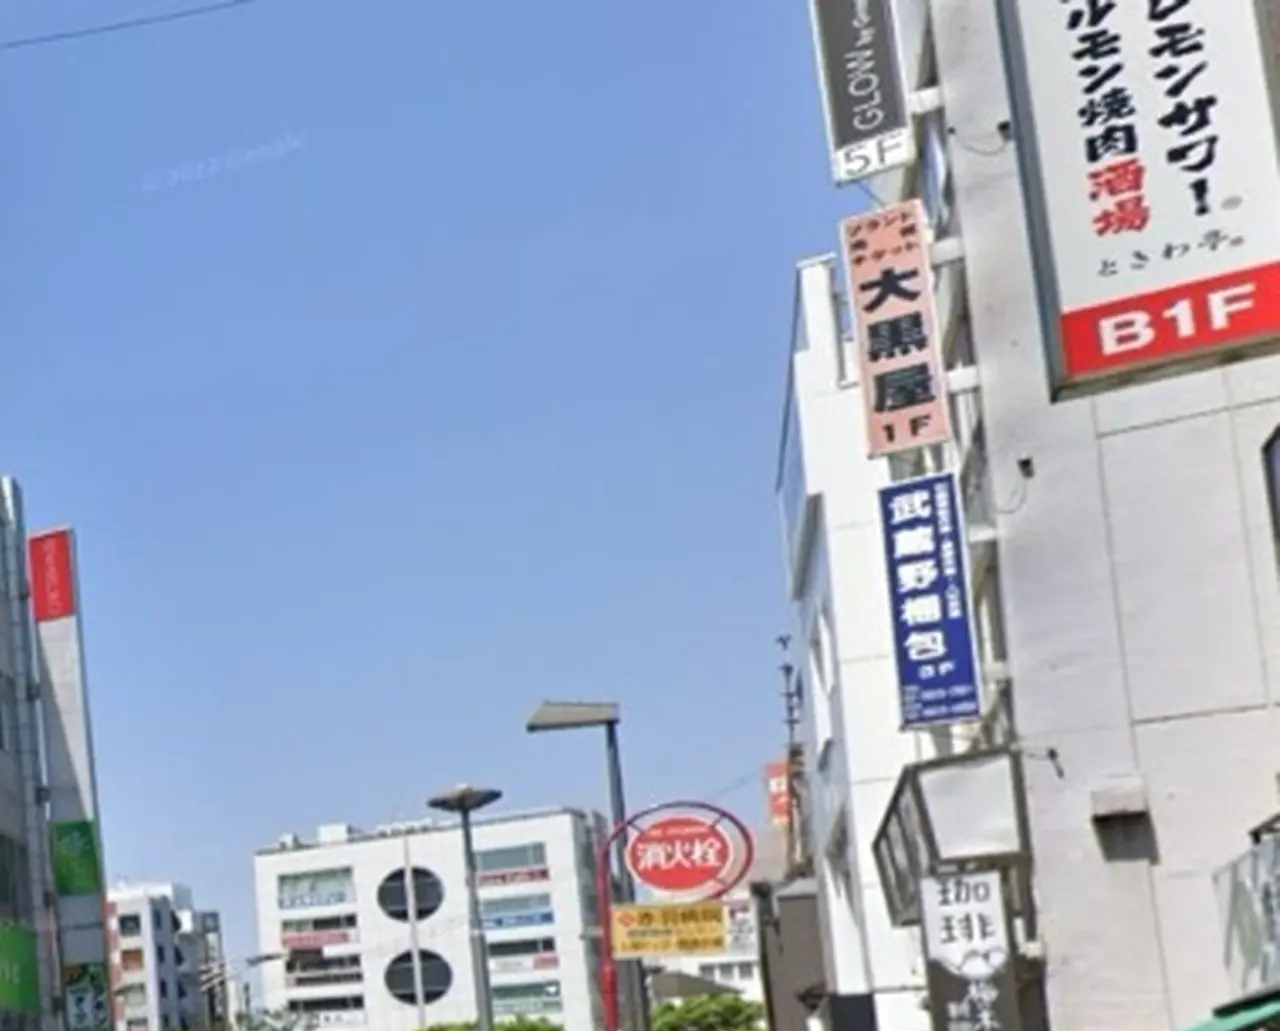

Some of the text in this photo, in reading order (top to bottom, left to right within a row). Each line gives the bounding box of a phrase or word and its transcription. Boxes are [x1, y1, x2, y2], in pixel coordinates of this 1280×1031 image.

[844, 49, 885, 131] GLOW
[858, 267, 937, 413] 大黒屋
[1098, 283, 1257, 357] B1F
[881, 414, 932, 443] 1F
[636, 837, 722, 870] 消火栓
[937, 880, 996, 944] 珈琲
